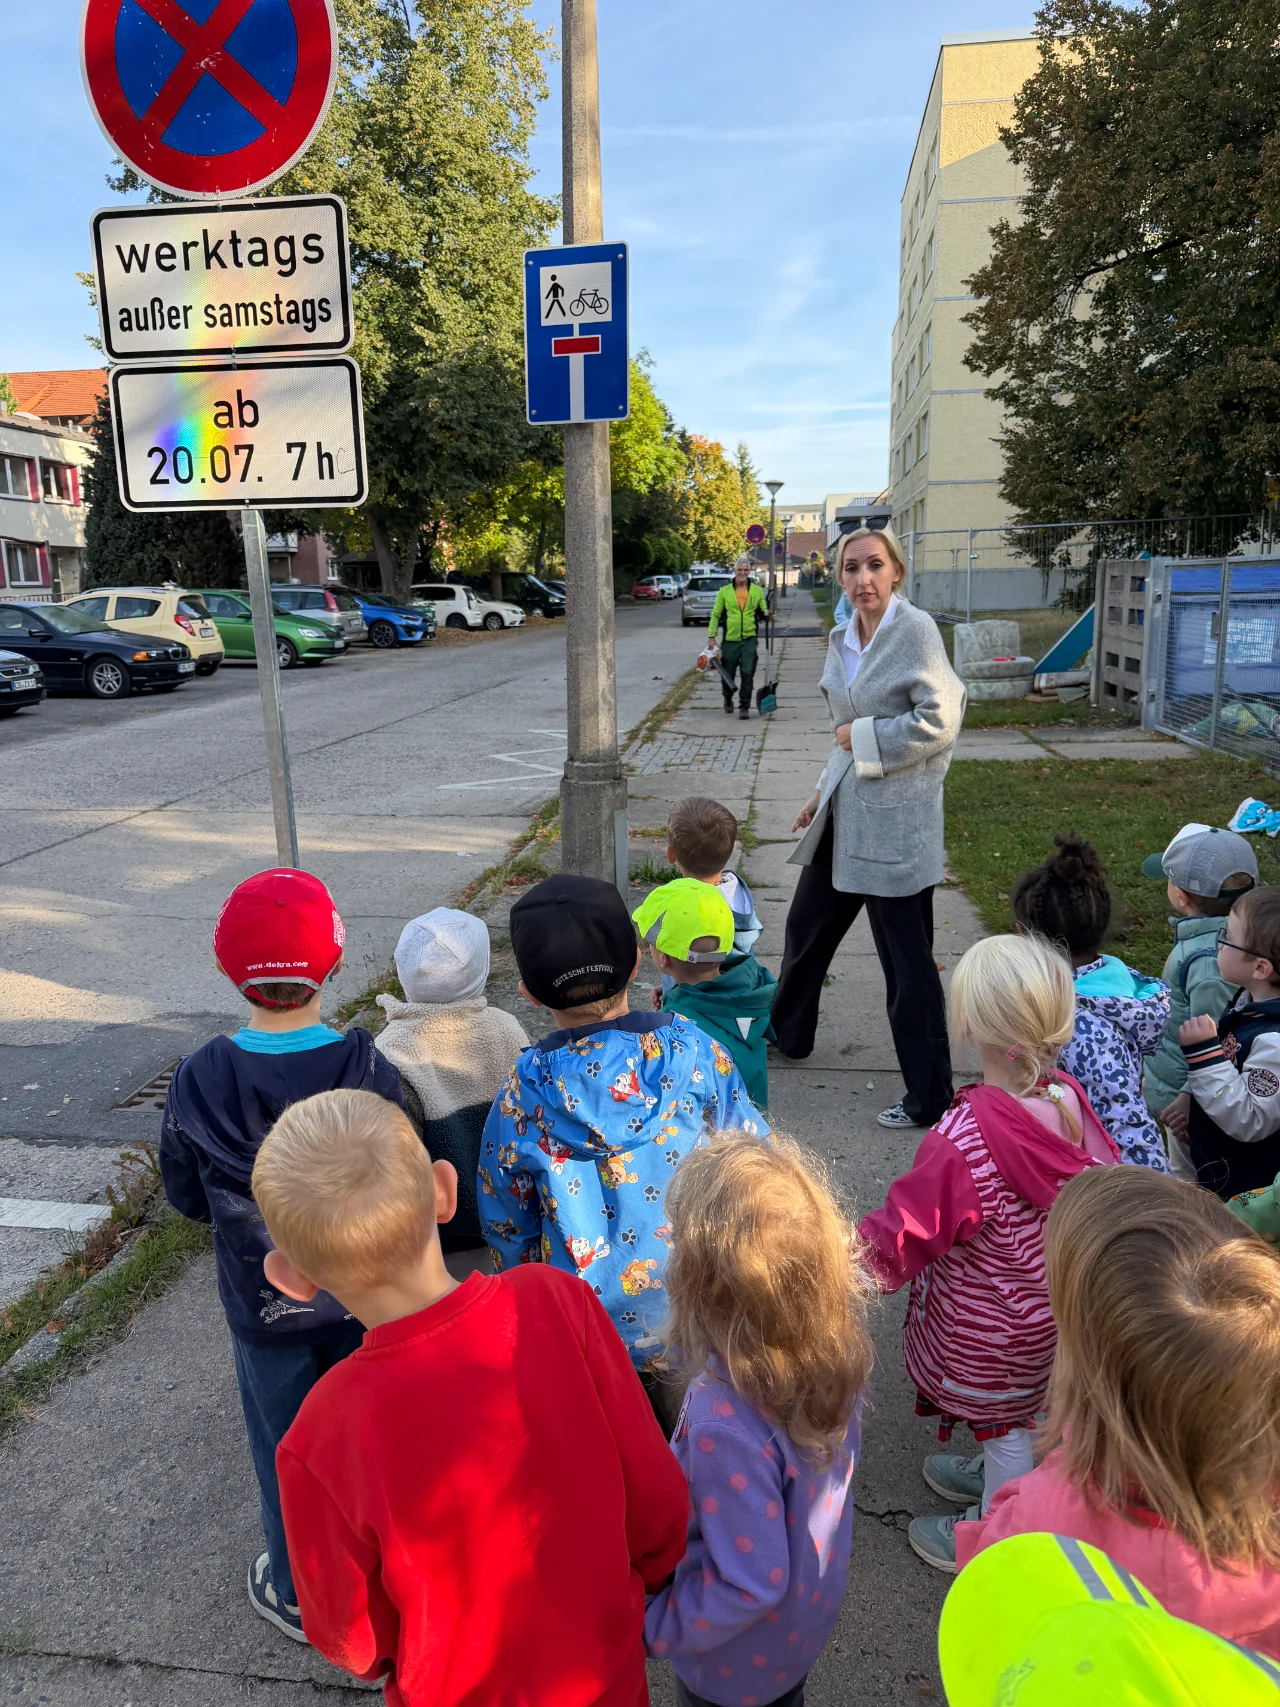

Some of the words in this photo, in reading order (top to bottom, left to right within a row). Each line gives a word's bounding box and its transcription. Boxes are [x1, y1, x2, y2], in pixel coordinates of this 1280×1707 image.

[115, 228, 325, 277] werktags
[118, 297, 193, 333] außer
[203, 293, 332, 333] samstags
[212, 389, 260, 430] ab
[146, 443, 264, 485] 20.07.
[246, 961, 309, 972] www.dekra.com
